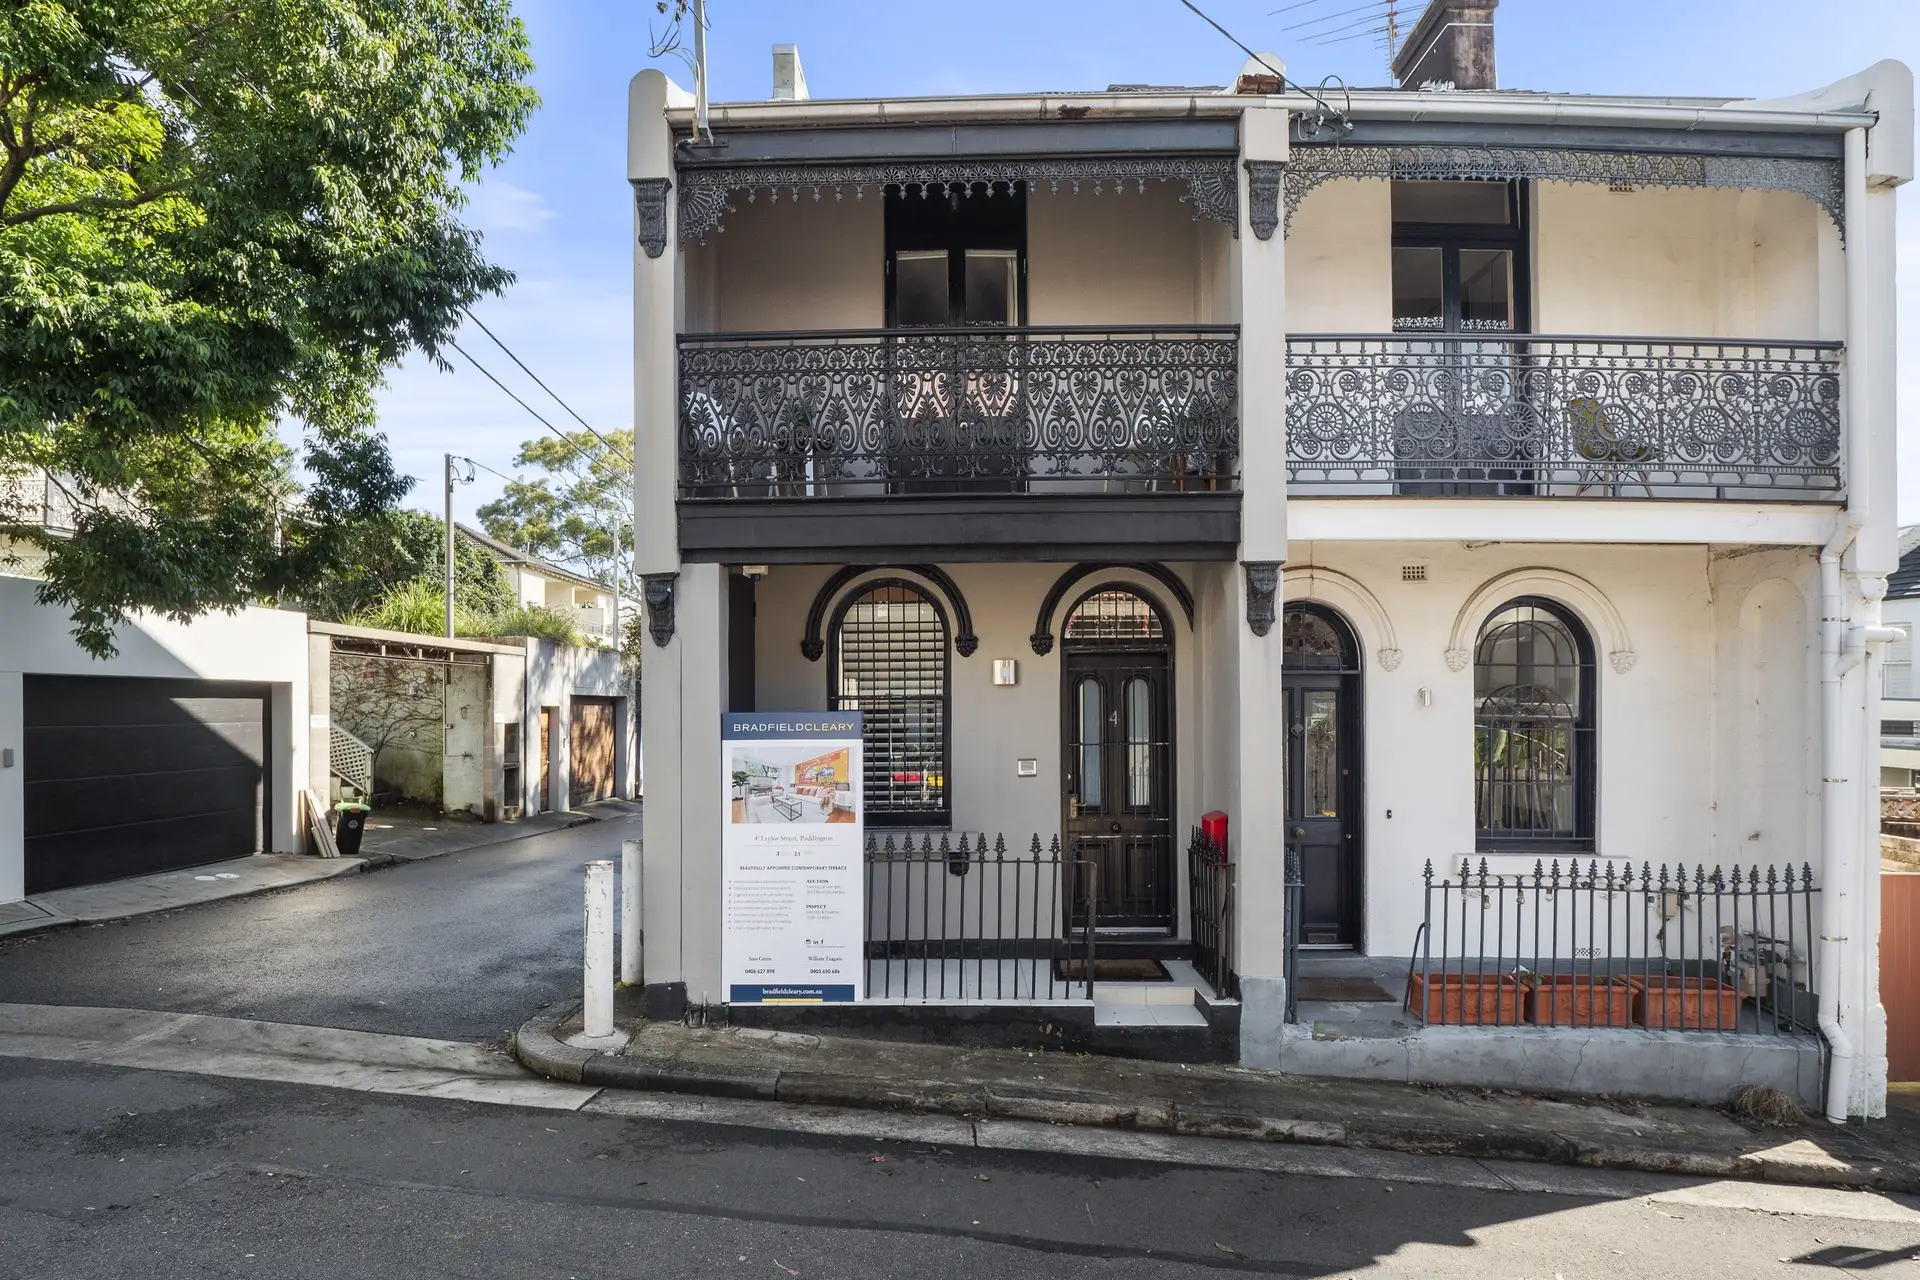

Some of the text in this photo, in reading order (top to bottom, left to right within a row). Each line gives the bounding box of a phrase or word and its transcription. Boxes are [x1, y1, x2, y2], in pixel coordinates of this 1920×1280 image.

[1108, 710, 1119, 725] 4
[733, 723, 854, 732] BRADFIELDCLEARY
[760, 835, 778, 843] Taylor
[800, 835, 833, 843] Paddington
